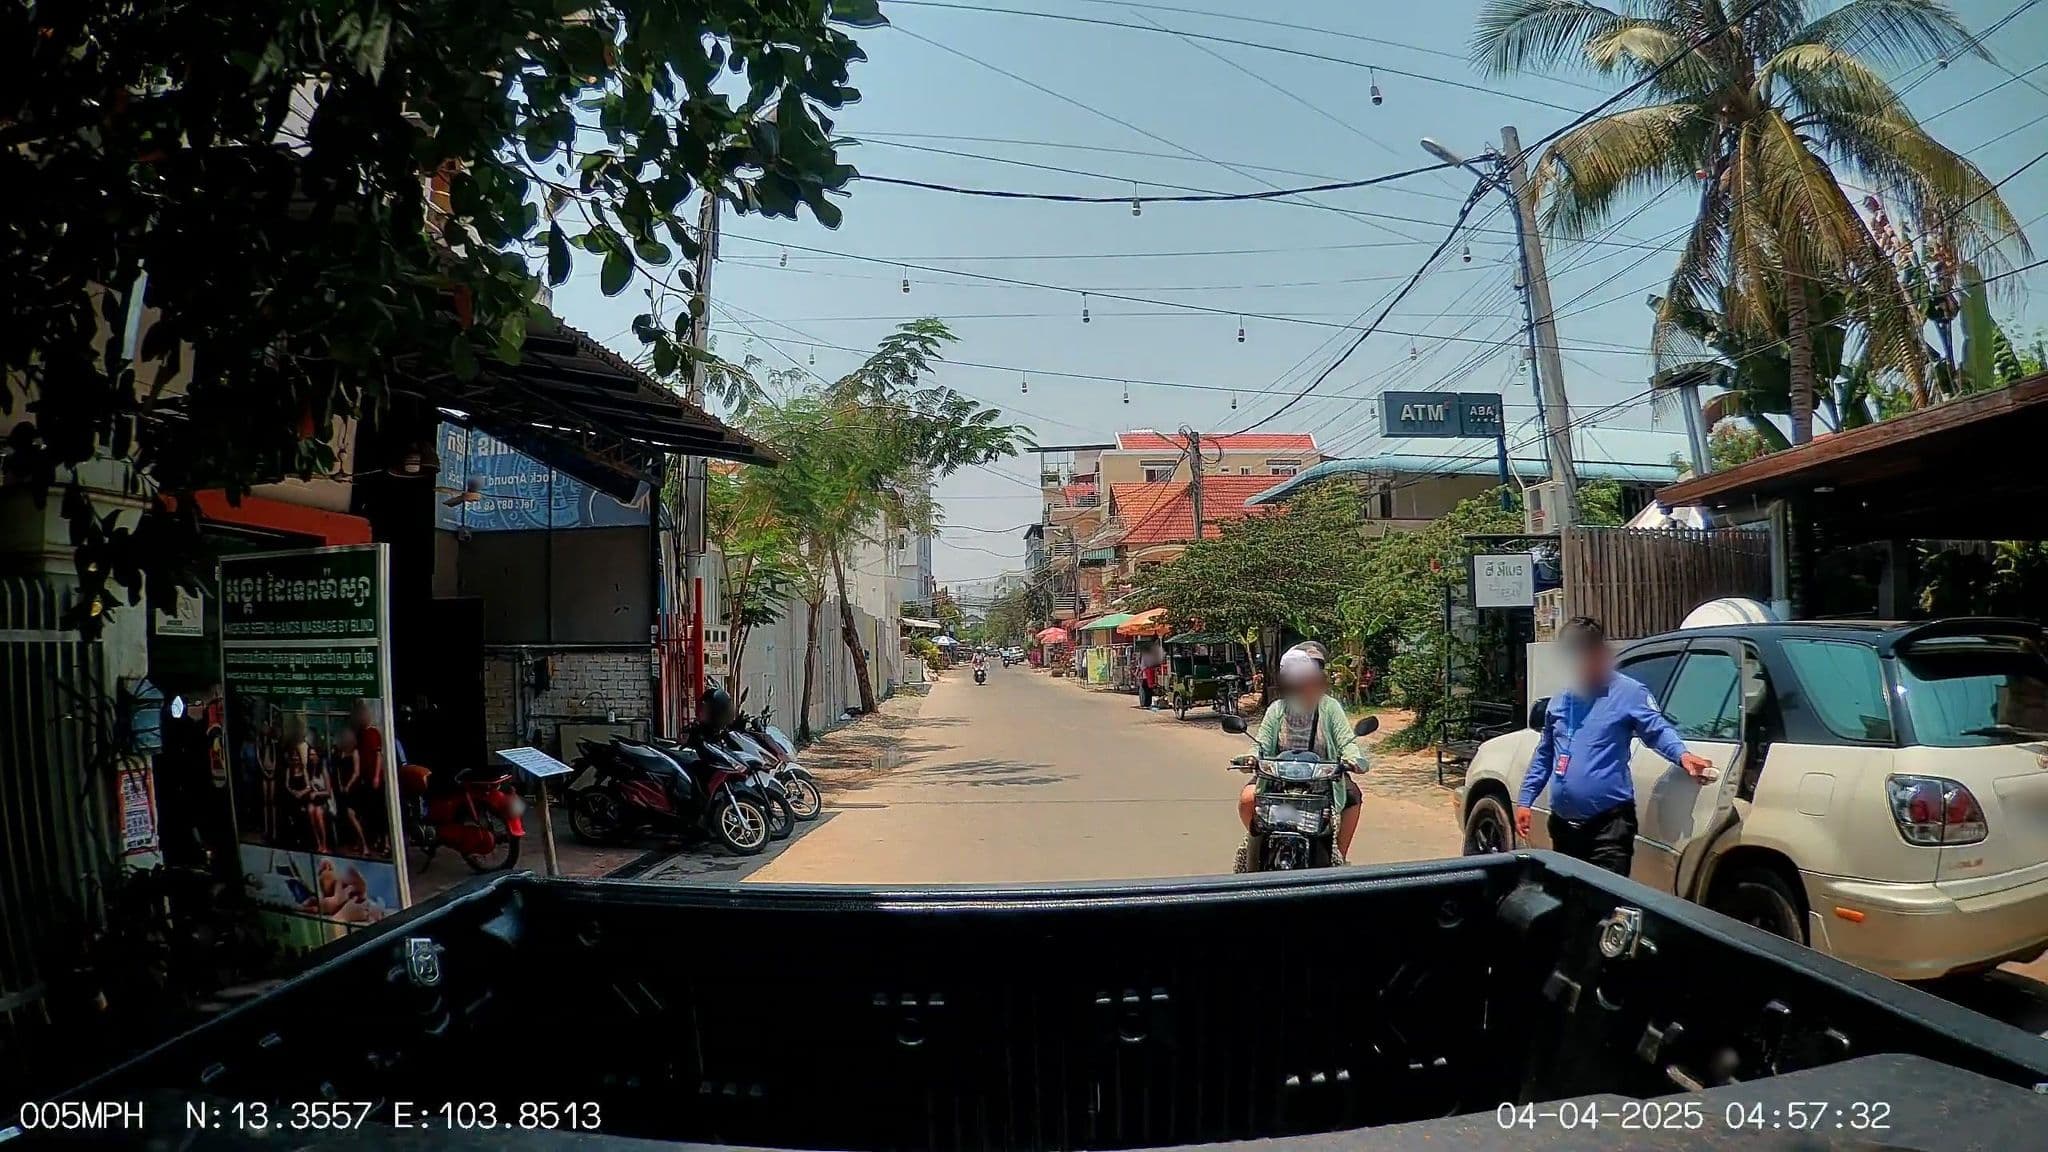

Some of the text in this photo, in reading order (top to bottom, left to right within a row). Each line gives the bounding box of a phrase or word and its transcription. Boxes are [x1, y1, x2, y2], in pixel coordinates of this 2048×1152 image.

[1400, 404, 1444, 422] ATM
[1469, 405, 1495, 416] ABA
[301, 620, 337, 633] MASSAGE
[338, 619, 349, 633] BY
[351, 618, 375, 632] BLIND
